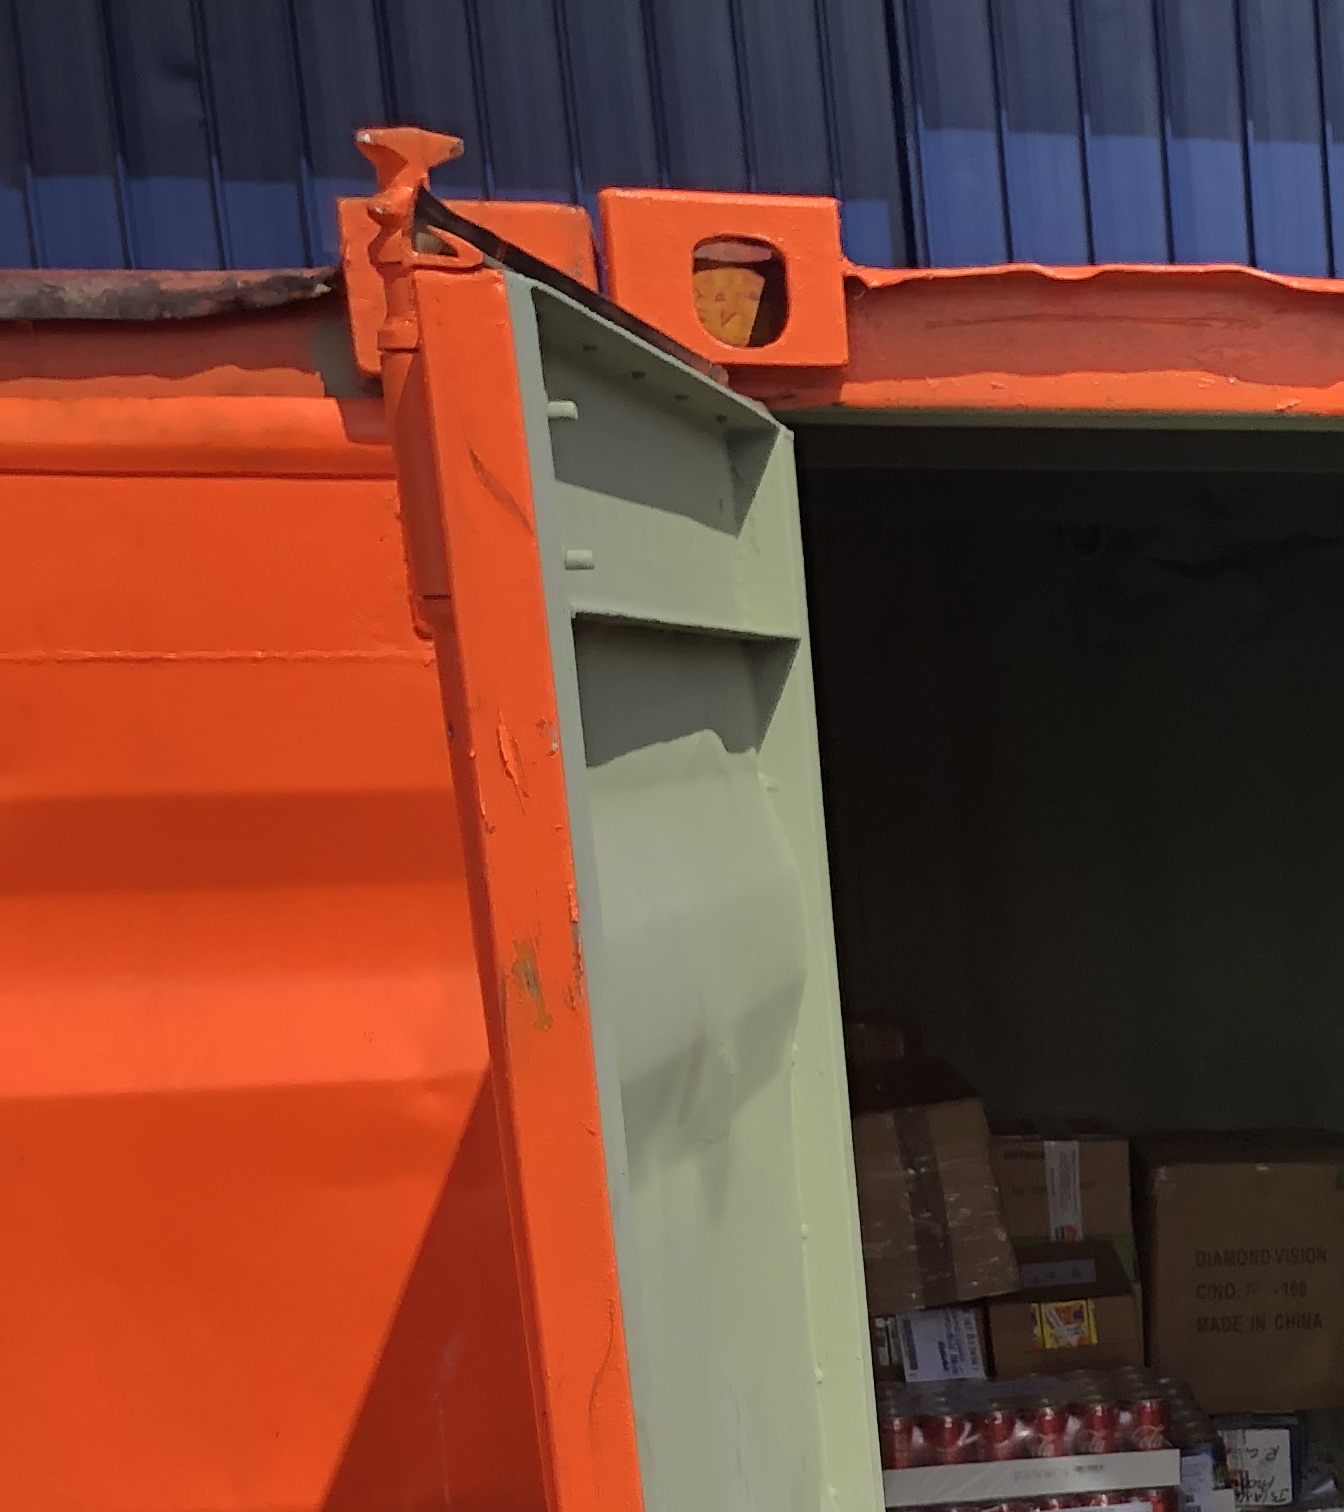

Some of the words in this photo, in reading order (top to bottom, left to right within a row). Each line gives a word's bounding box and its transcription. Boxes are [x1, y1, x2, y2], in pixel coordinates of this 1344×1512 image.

[1195, 1247, 1271, 1268] DIAMOND
[1274, 1246, 1328, 1266] VISION
[1196, 1315, 1243, 1333] MADE
[1250, 1313, 1266, 1332] IN
[1273, 1311, 1323, 1331] CHINA
